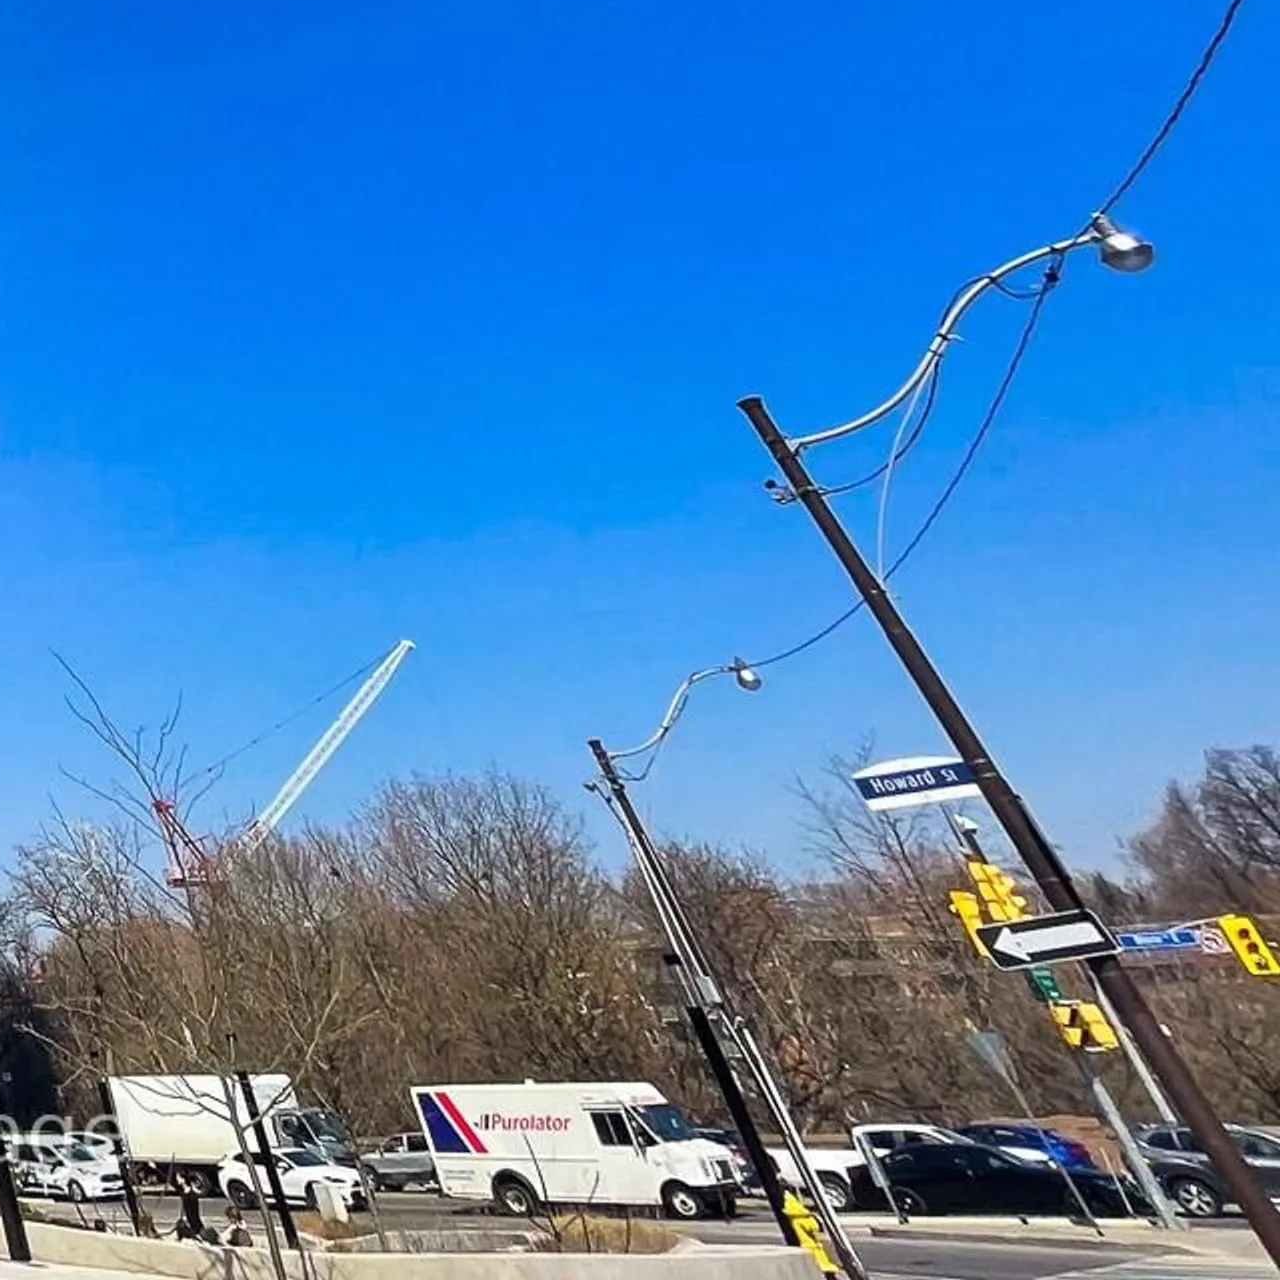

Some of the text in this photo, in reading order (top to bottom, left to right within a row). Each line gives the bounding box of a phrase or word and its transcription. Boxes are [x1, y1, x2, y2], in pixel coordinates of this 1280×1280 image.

[869, 768, 959, 794] Howard St
[492, 1113, 571, 1131] Purolator
